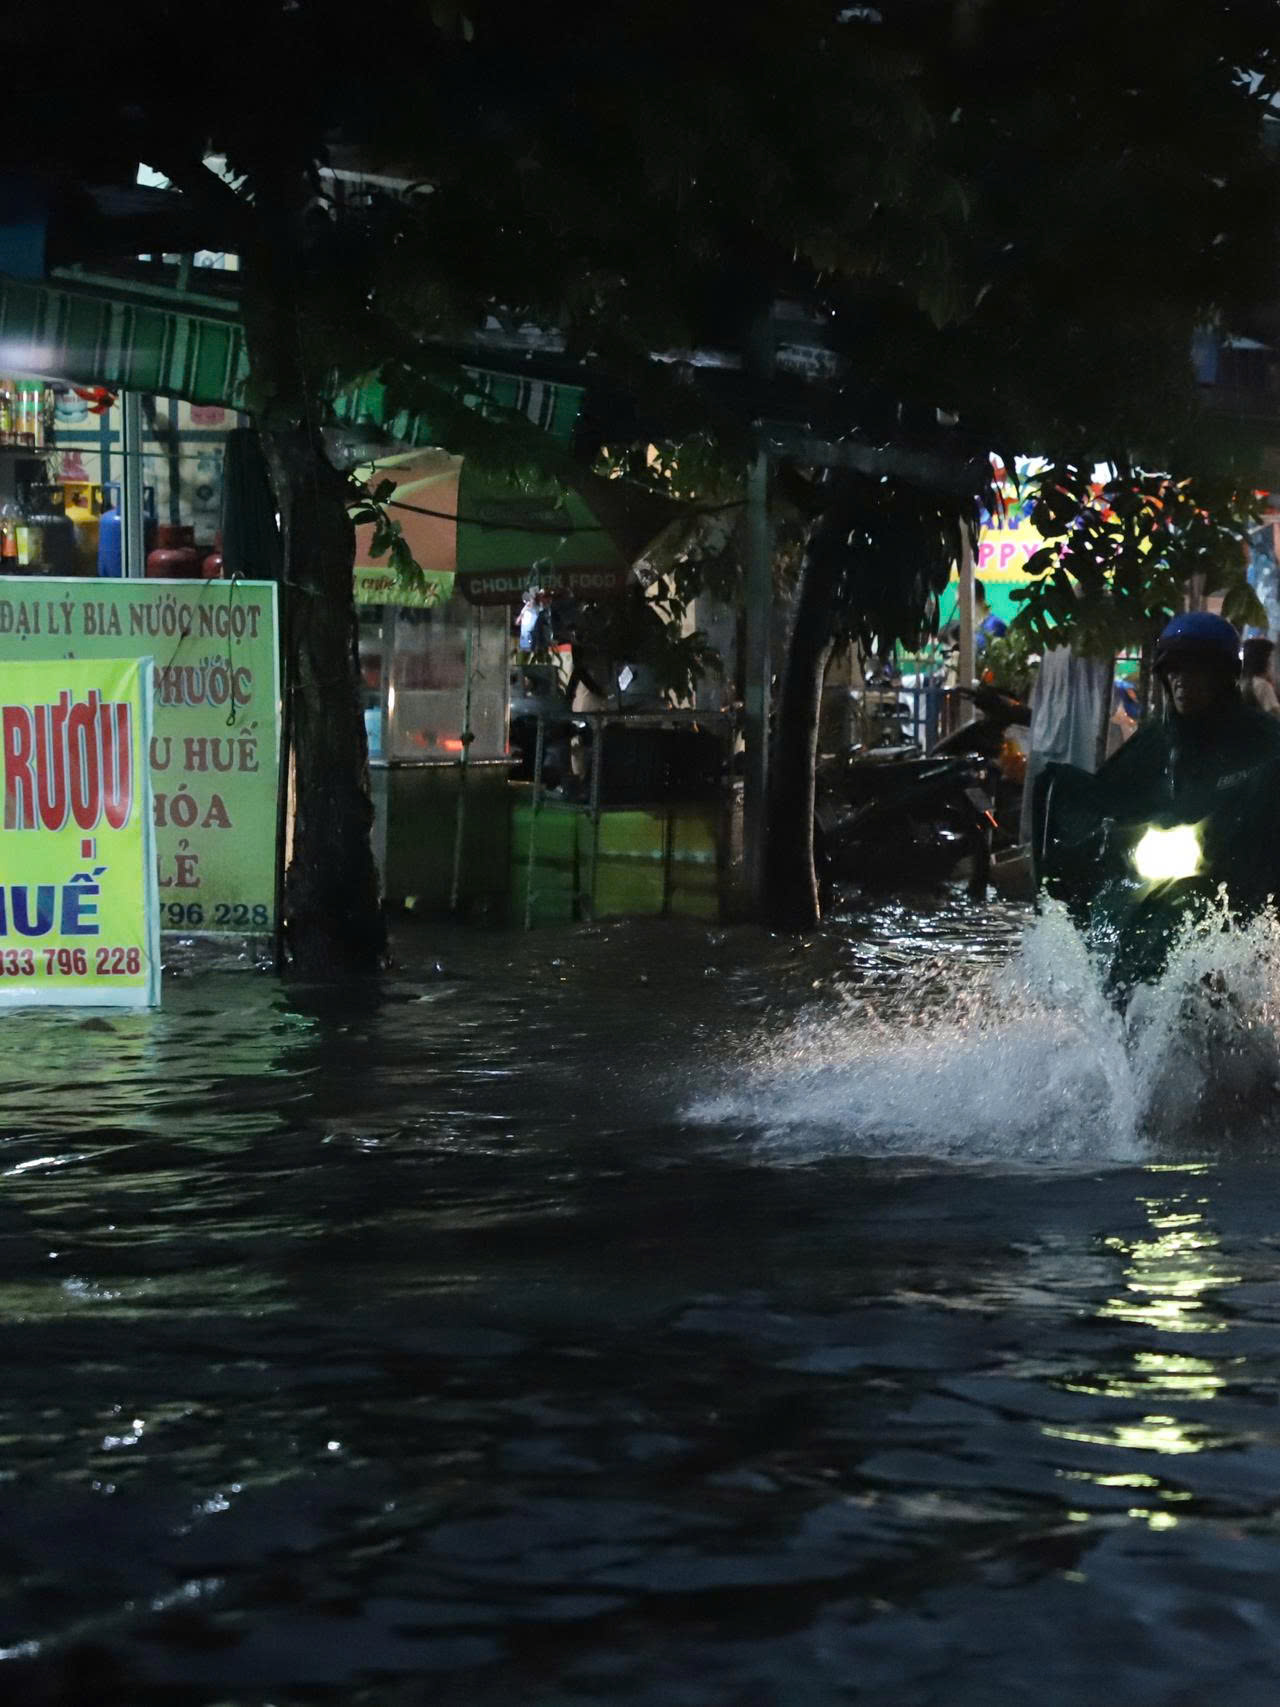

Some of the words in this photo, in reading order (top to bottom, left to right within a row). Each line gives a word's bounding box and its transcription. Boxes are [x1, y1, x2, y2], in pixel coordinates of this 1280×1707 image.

[570, 573, 617, 589] FOOD
[0, 600, 41, 641] ĐẠI
[47, 592, 75, 635] LÝ
[83, 602, 122, 637] BIA
[129, 594, 192, 638] NƯỚC
[199, 603, 261, 645] NGỌT
[183, 721, 260, 772] HUẾ
[2, 688, 134, 859] RƯỢU
[214, 904, 269, 926] 228
[43, 948, 87, 976] 796
[96, 946, 140, 976] 228
